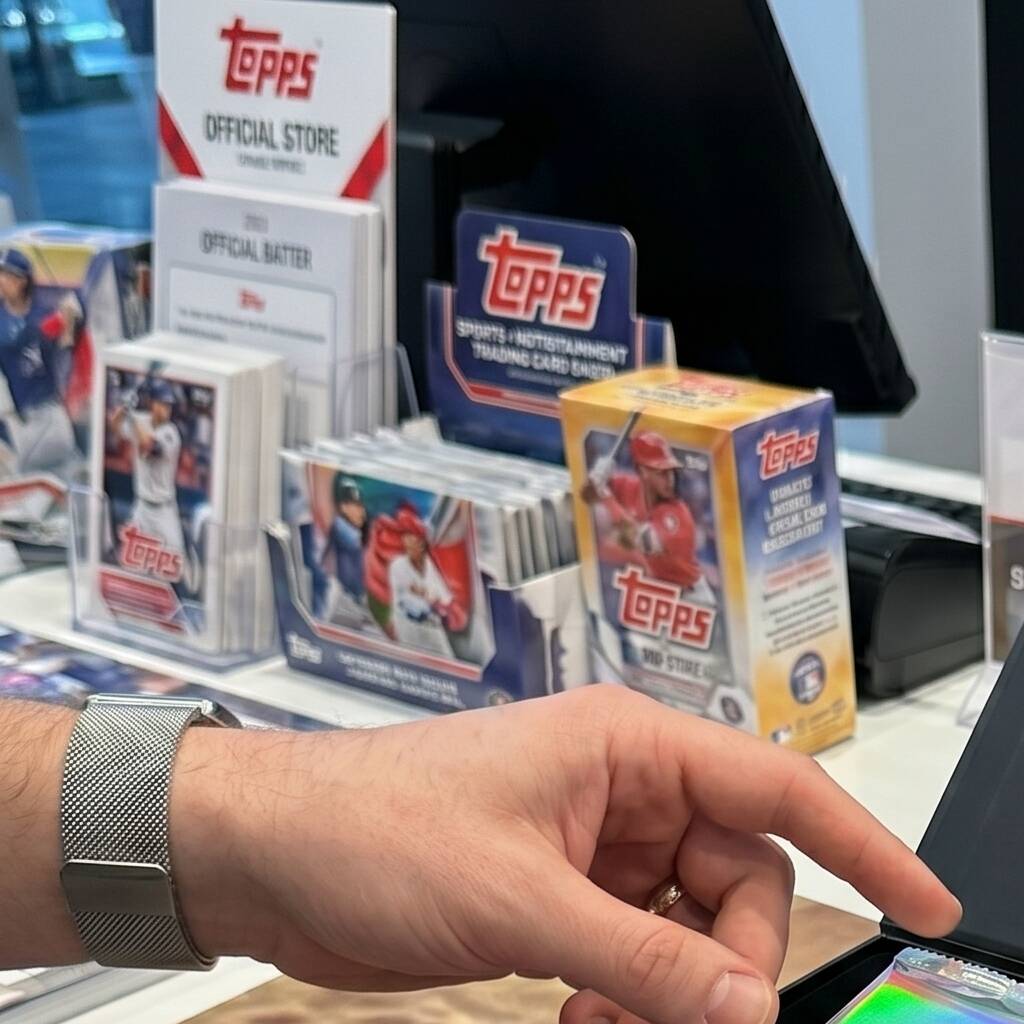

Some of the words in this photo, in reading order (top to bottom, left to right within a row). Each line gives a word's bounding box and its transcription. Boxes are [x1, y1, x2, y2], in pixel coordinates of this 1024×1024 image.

[205, 113, 280, 151] OFFICIAL
[283, 123, 340, 157] STORE
[201, 231, 259, 263] OFFICIAL
[478, 225, 606, 331] Topps
[614, 564, 716, 649] Topps
